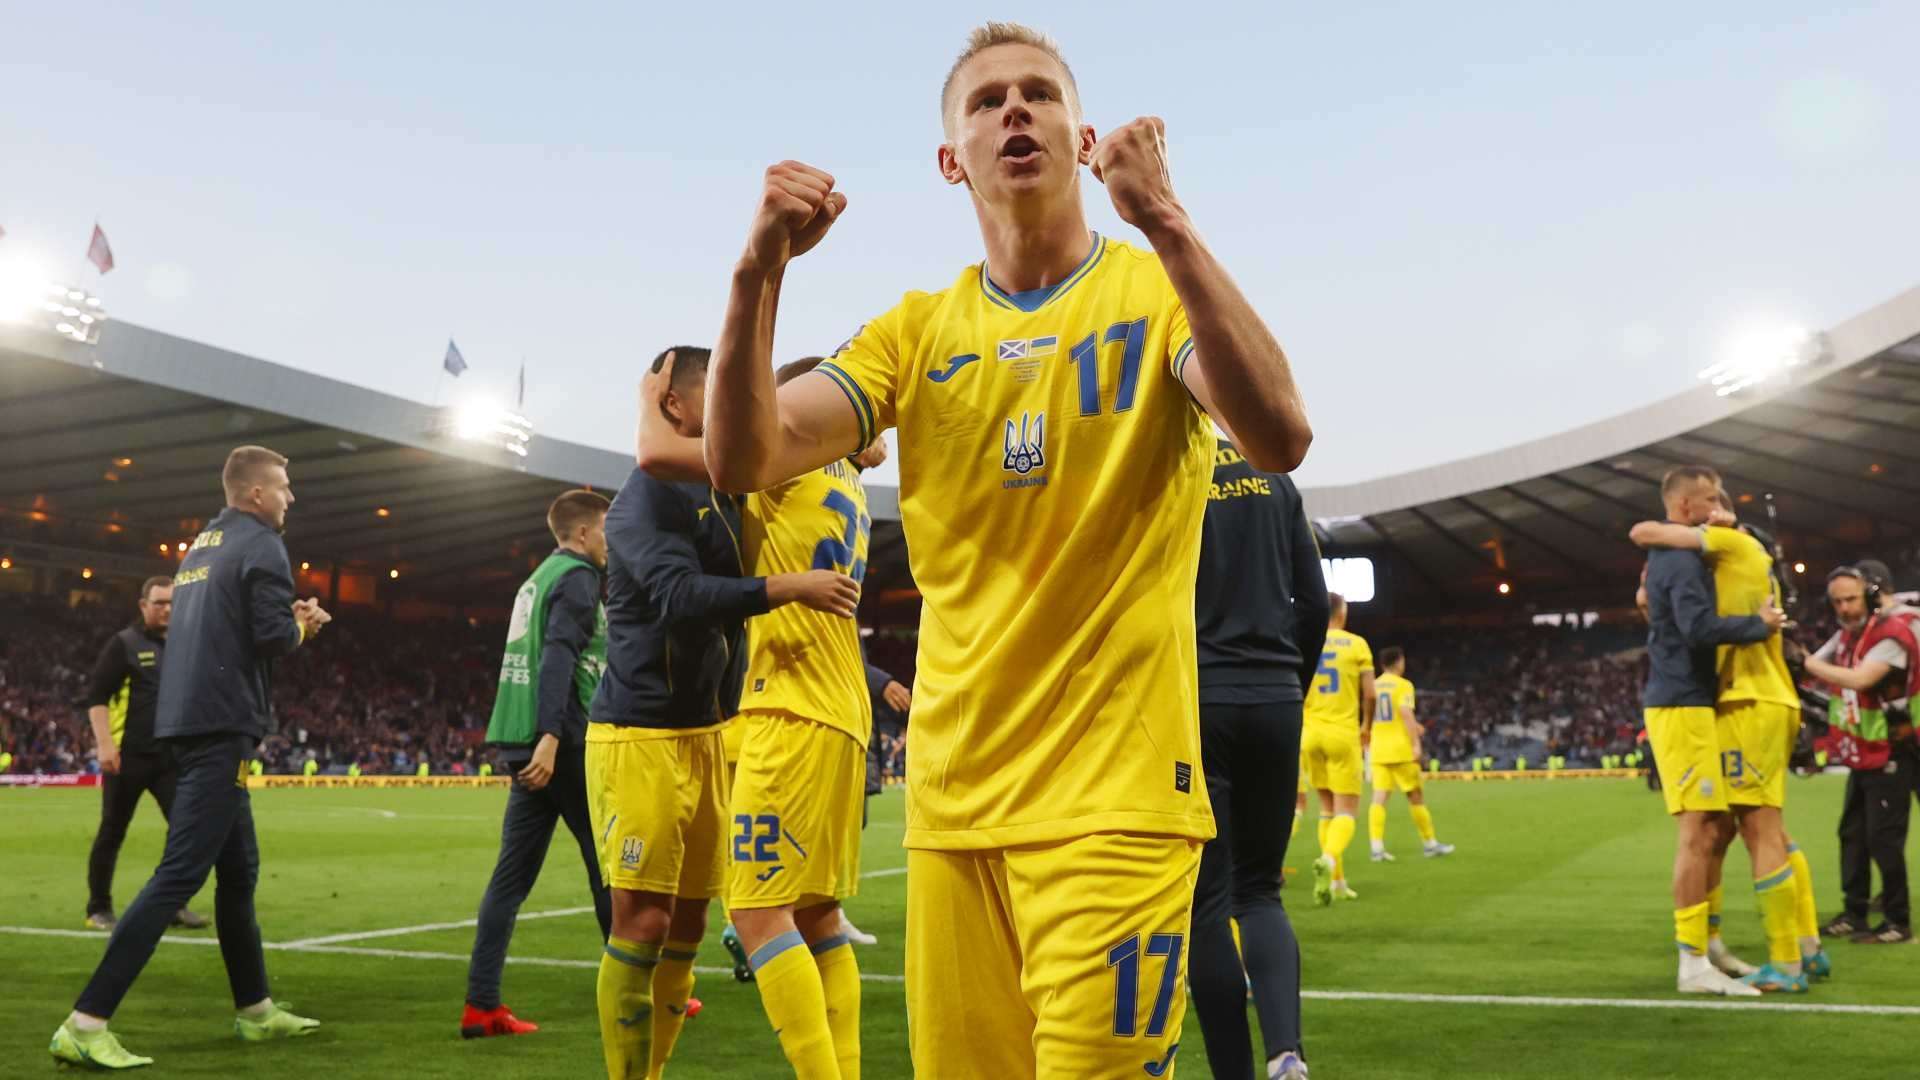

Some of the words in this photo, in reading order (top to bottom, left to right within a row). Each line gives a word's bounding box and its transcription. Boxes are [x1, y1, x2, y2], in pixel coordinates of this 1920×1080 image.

[1069, 315, 1148, 416] 17
[1002, 476, 1049, 489] UKRAINE
[1208, 477, 1272, 500] RAINE
[1316, 652, 1340, 694] 5
[1720, 749, 1743, 778] 13
[733, 814, 781, 862] 22
[1107, 932, 1184, 1037] 17
